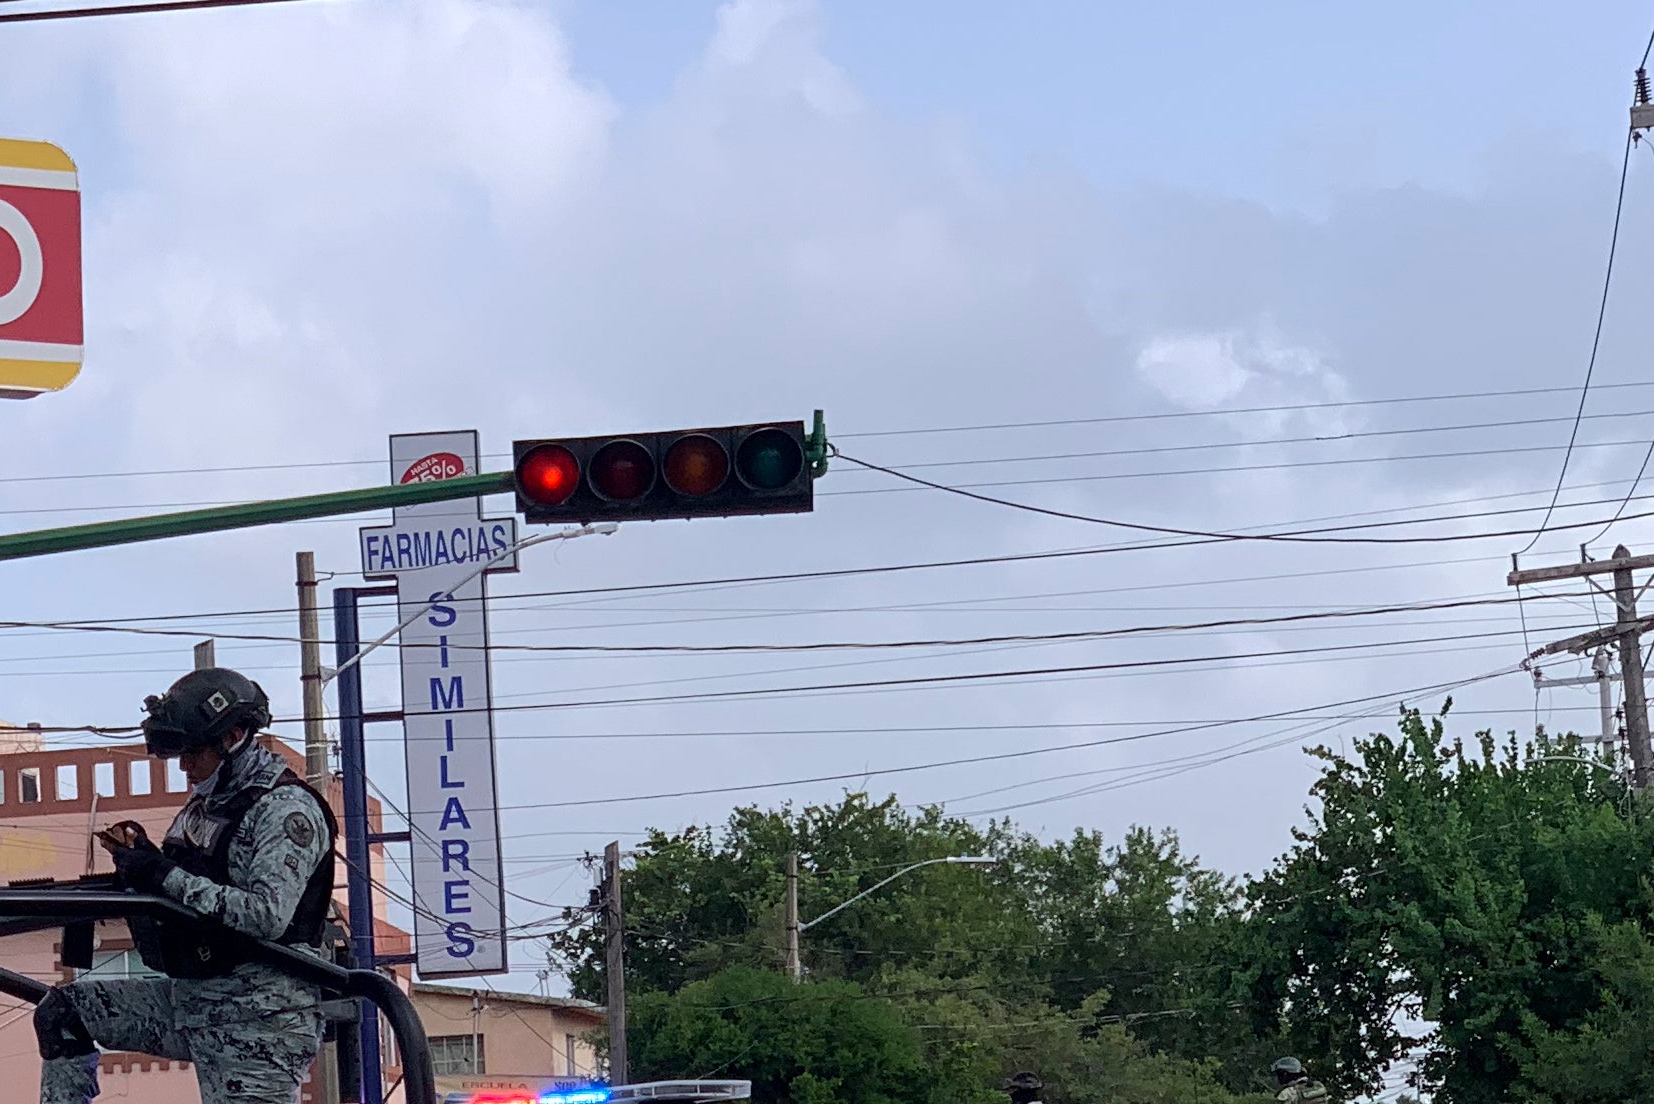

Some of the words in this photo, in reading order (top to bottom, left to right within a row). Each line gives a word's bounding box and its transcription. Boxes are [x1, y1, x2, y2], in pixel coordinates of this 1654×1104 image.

[410, 456, 439, 476] HASTA
[366, 524, 507, 572] FARMACIAS
[427, 590, 475, 960] SIMILARES
